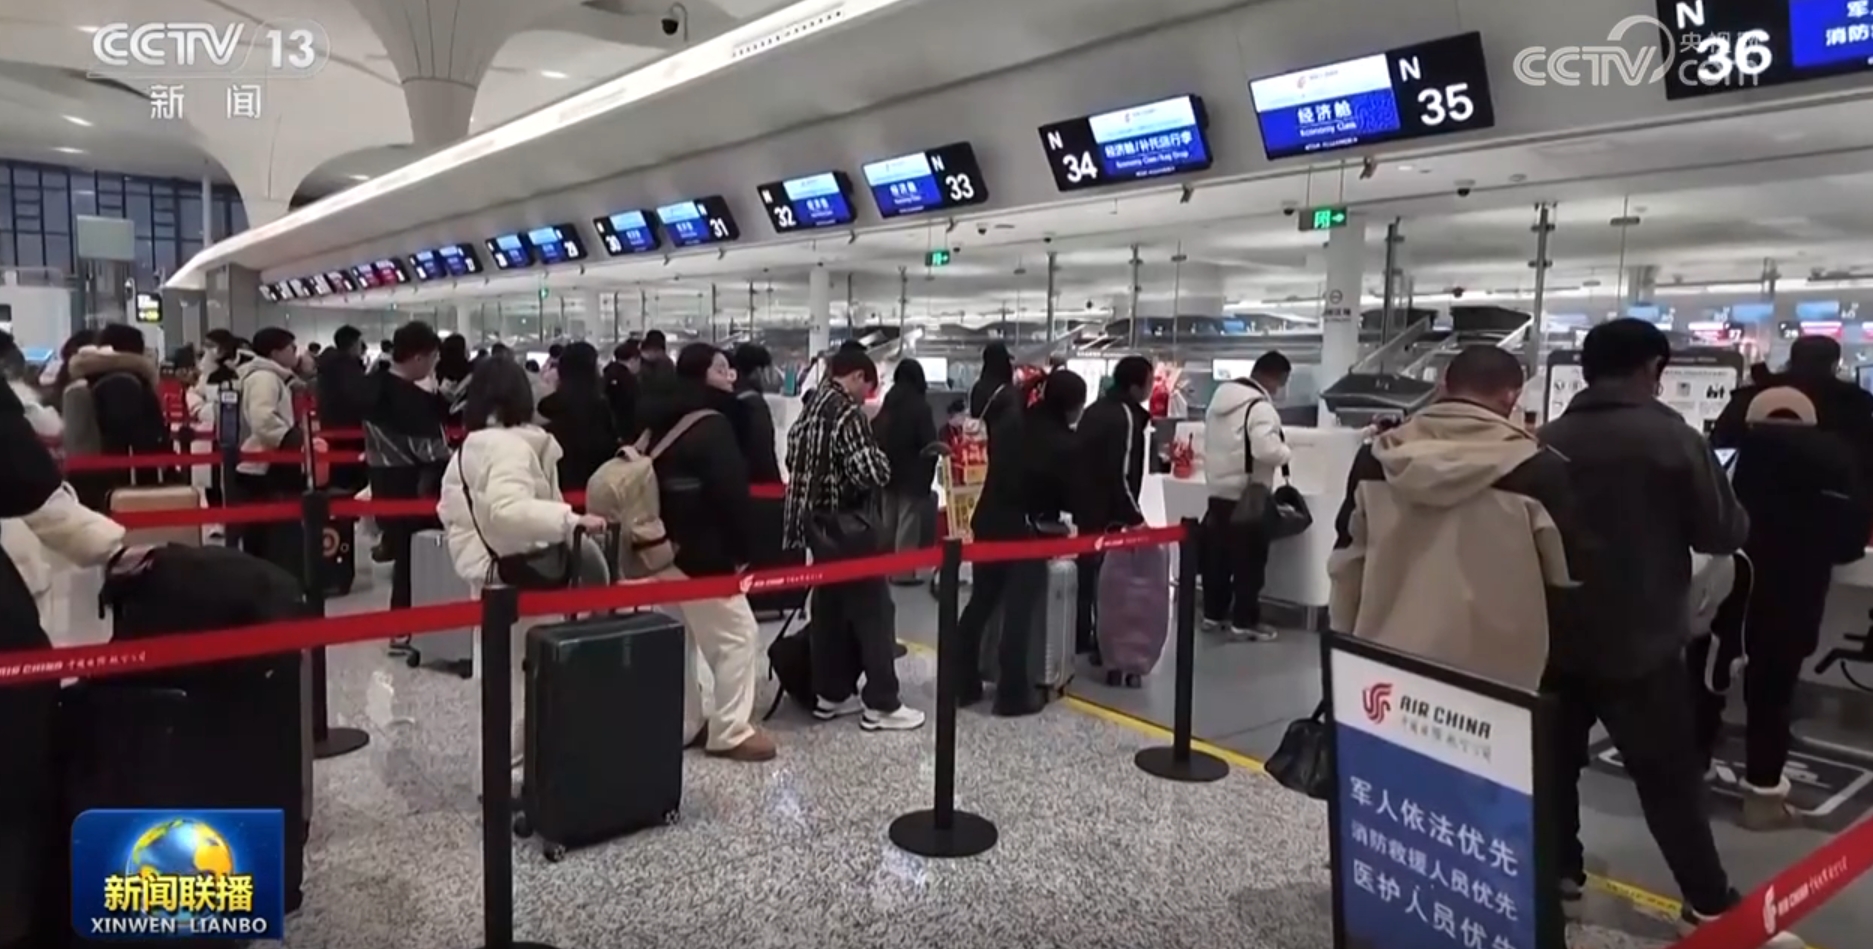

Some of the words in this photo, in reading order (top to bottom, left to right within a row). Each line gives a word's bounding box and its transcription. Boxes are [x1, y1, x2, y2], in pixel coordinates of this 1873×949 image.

[1676, 0, 1705, 29] N
[1846, 0, 1873, 18] 军
[1825, 23, 1873, 46] 消防
[1697, 28, 1773, 82] 36
[1399, 56, 1421, 82] N
[1297, 99, 1352, 124] 经济舱
[1417, 83, 1474, 126] 35
[1047, 131, 1063, 150] N
[931, 155, 945, 171] N
[1062, 151, 1098, 182] 34
[762, 189, 773, 203] N
[945, 173, 974, 200] 33
[709, 217, 729, 238] 31
[774, 205, 796, 227] 32
[1400, 695, 1430, 718] AIR
[1433, 706, 1491, 740] CHINA
[1350, 775, 1518, 877] 军人依法优先
[1351, 818, 1517, 921] 消防救援人员优先
